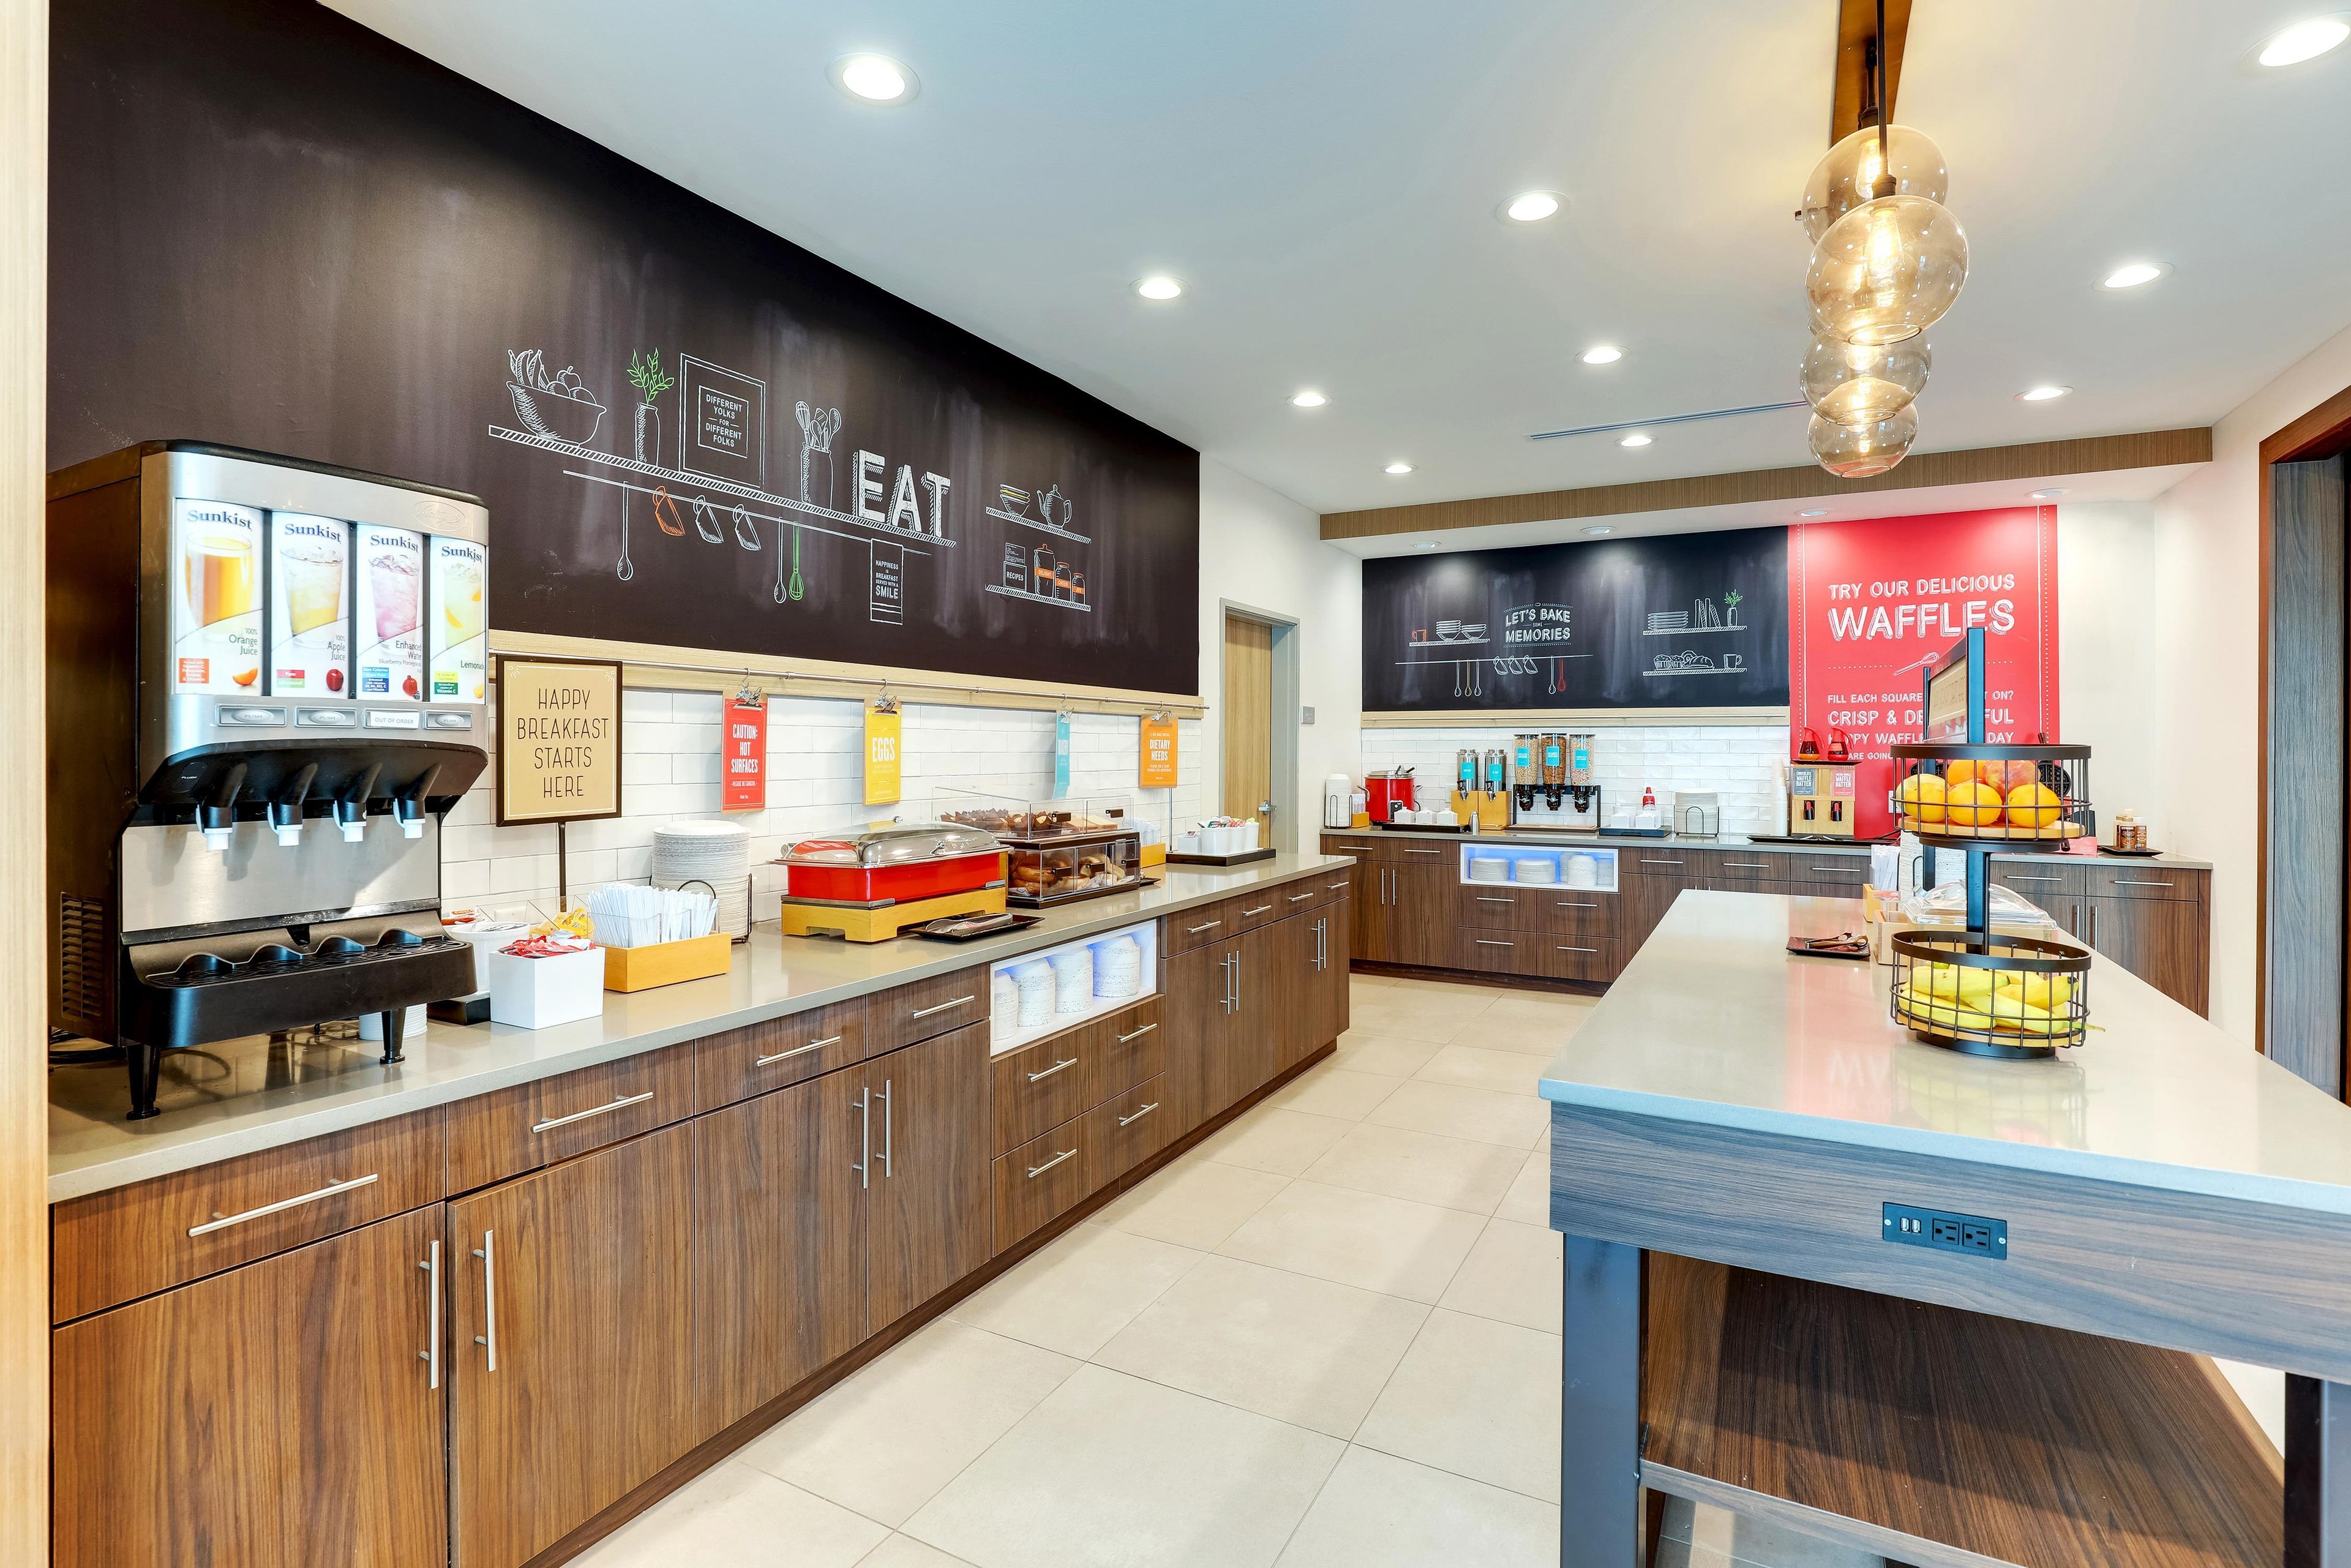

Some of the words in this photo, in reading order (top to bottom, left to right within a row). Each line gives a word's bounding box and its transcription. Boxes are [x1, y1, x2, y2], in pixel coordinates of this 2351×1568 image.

[706, 394, 742, 412] DIFFERENT
[714, 405, 735, 419] YOLKS
[705, 422, 742, 440] DIFFERENT
[713, 434, 735, 447] FOLKS
[852, 449, 950, 538] EAT
[187, 509, 252, 530] Sunkist
[284, 523, 341, 543] Sunkist
[370, 535, 419, 553] Sunkist
[441, 546, 482, 563] Sunkist
[876, 560, 899, 570] HAPPINESS
[876, 572, 898, 582] BREAKFAST
[1006, 571, 1024, 582] RECIPES
[1038, 569, 1051, 577] DELIGHT
[876, 585, 899, 599] SMILE
[1828, 583, 1862, 600] TRY
[1870, 580, 1909, 598] OUR
[1916, 574, 2015, 596] DELICIOUS
[1505, 609, 1536, 627] LET'S
[1540, 608, 1571, 623] BAKE
[1828, 599, 2015, 641] WAFFLES
[228, 634, 258, 647] Orange
[1505, 627, 1570, 643] MEMORIES
[239, 645, 258, 655] Juice
[327, 641, 346, 653] Apple
[396, 640, 422, 651] Enhanced
[331, 651, 345, 661] Juice
[408, 651, 422, 660] Water
[539, 688, 590, 710] HAPPY
[1828, 694, 1847, 704] FILL
[1851, 693, 1877, 703] EACH
[1881, 692, 1923, 703] SQUARE
[1992, 690, 2014, 700] ON?
[1828, 709, 1879, 726] CRISP
[1886, 710, 1897, 726] &
[517, 718, 609, 740] BREAKFAST
[732, 724, 758, 740] CAUTION:
[740, 741, 751, 756] HOT
[872, 737, 895, 762] EGGS
[1149, 739, 1171, 750] DIETARY
[534, 746, 592, 769] STARTS
[1151, 751, 1168, 761] NEEDS
[731, 758, 758, 773] SURFACES
[543, 776, 584, 798] HERE
